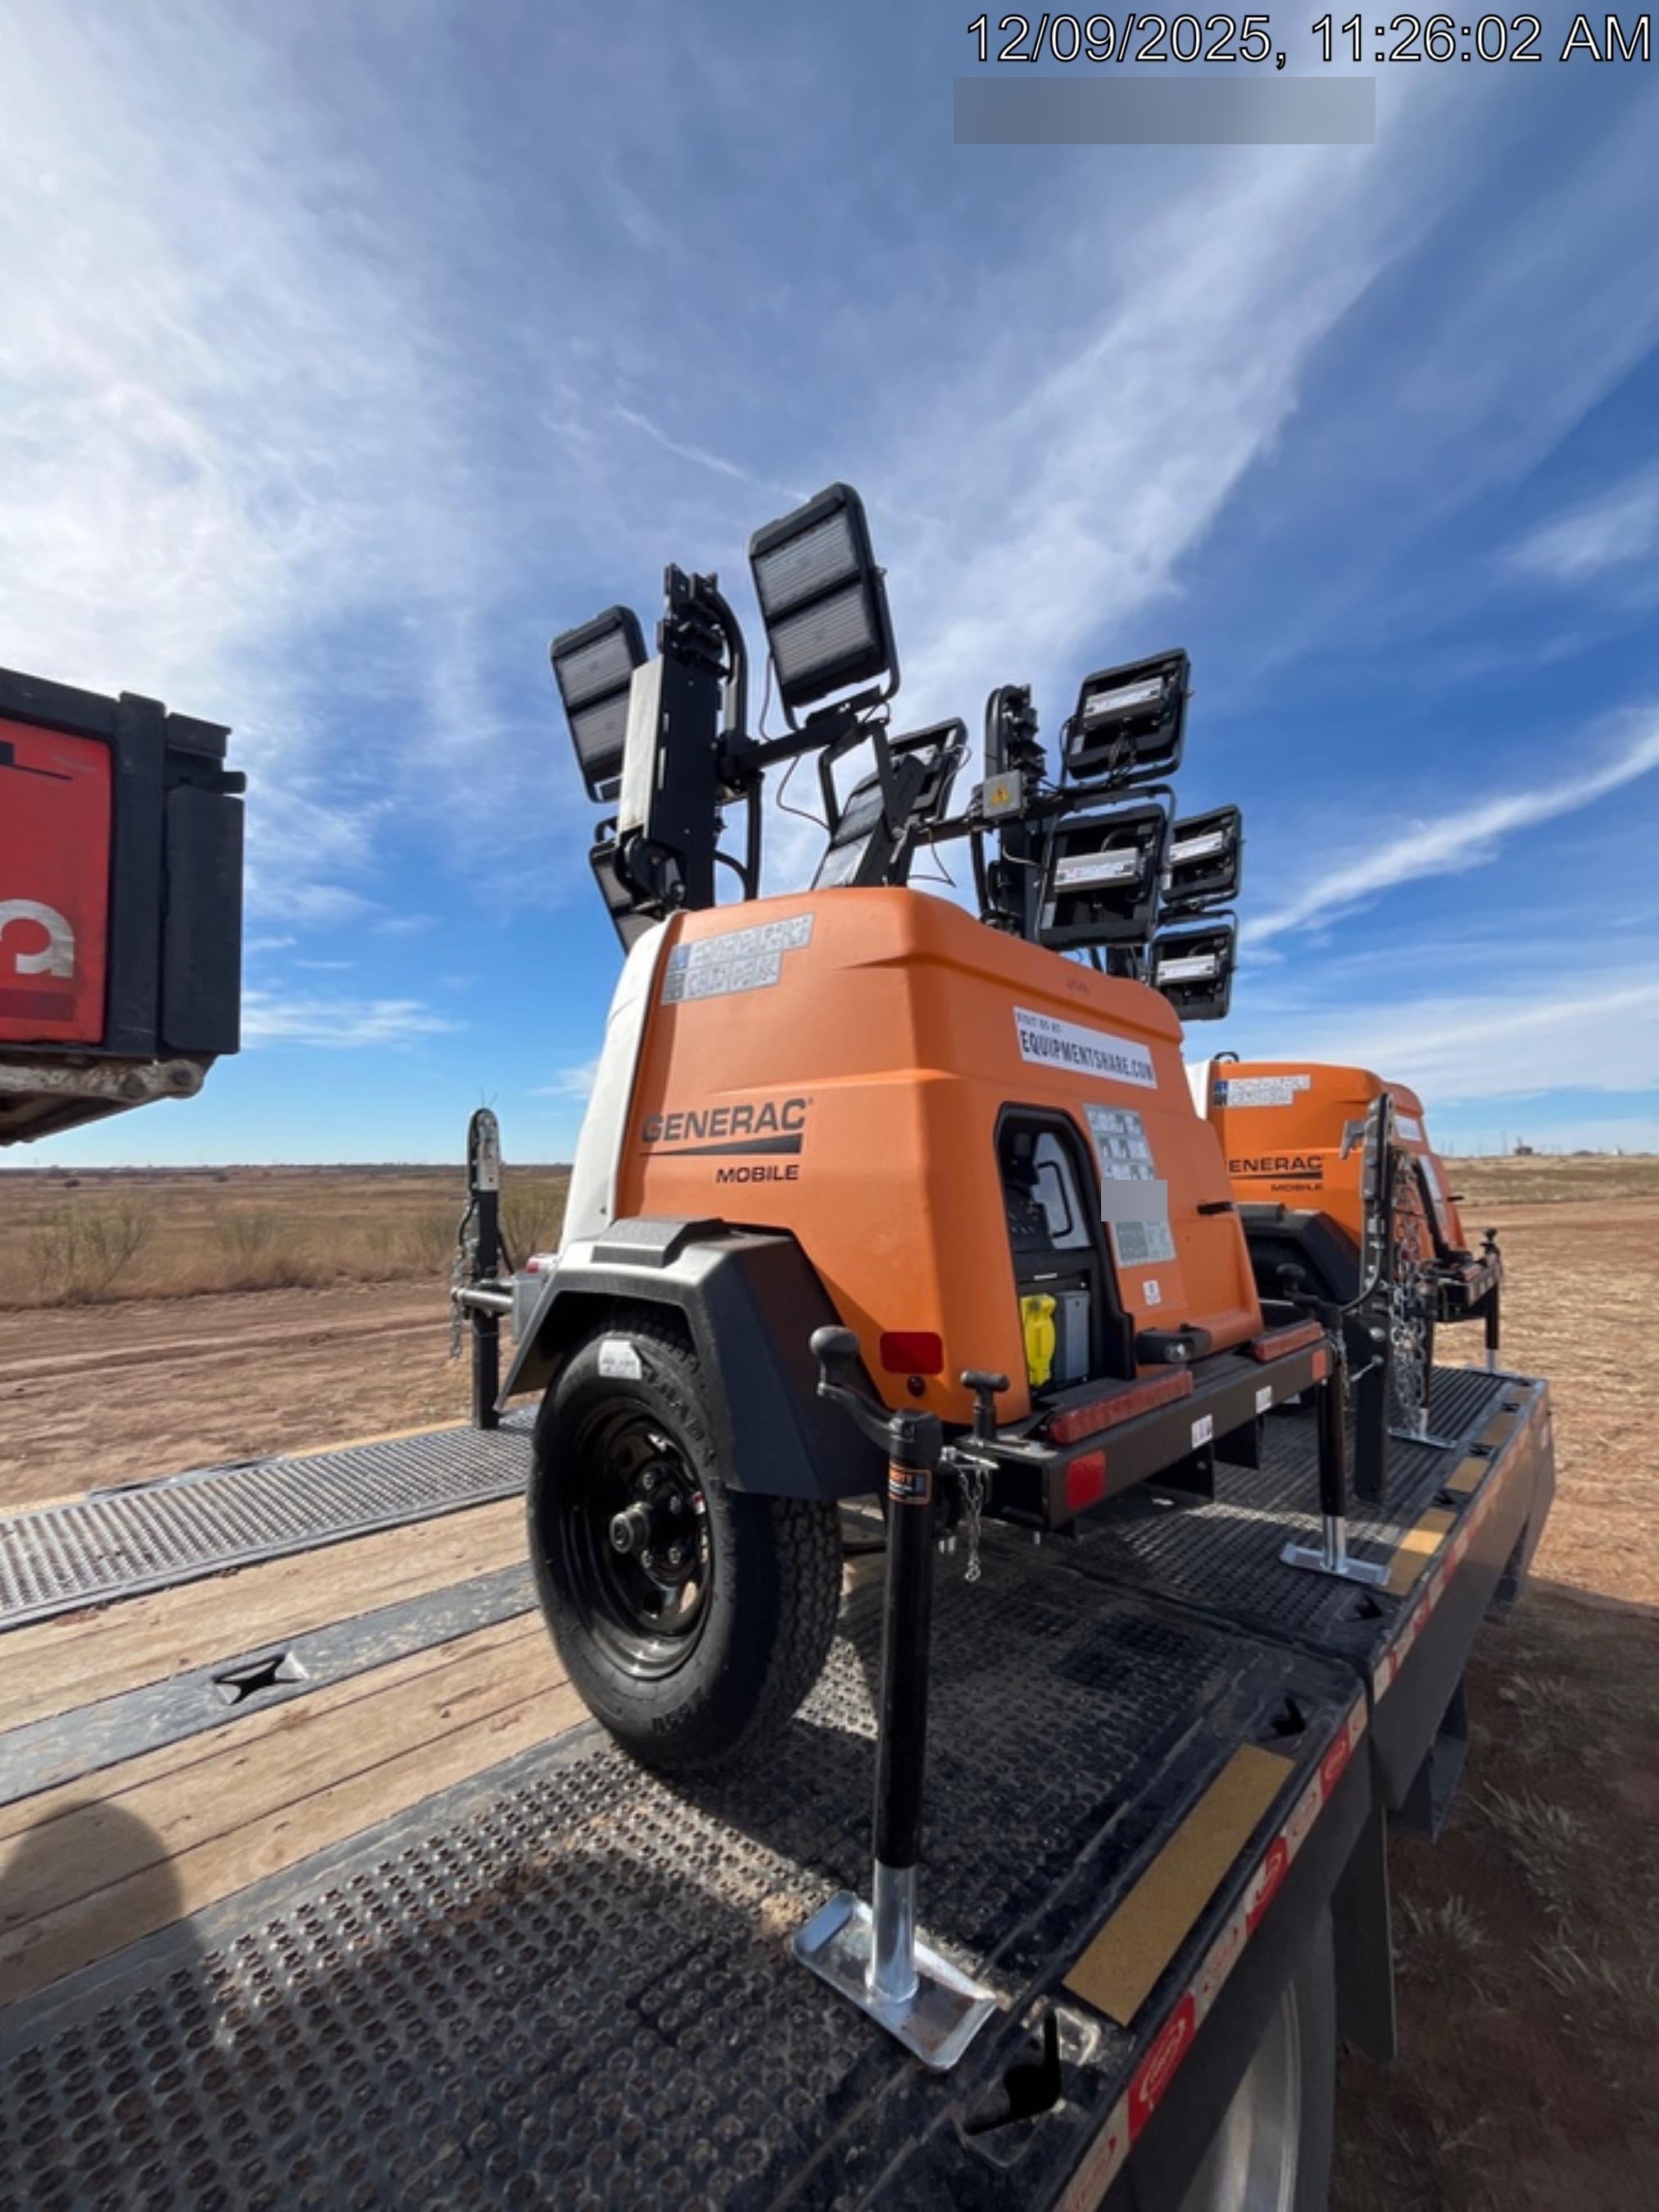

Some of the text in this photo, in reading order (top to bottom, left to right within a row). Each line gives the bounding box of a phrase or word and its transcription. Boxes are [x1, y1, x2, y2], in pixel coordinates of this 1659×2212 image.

[1020, 1029, 1154, 1082] EQUIPMENTSHARE.COM
[641, 1098, 806, 1144] GENERAC
[715, 1164, 800, 1183] MOBILE
[1225, 1155, 1324, 1173] ENERAC
